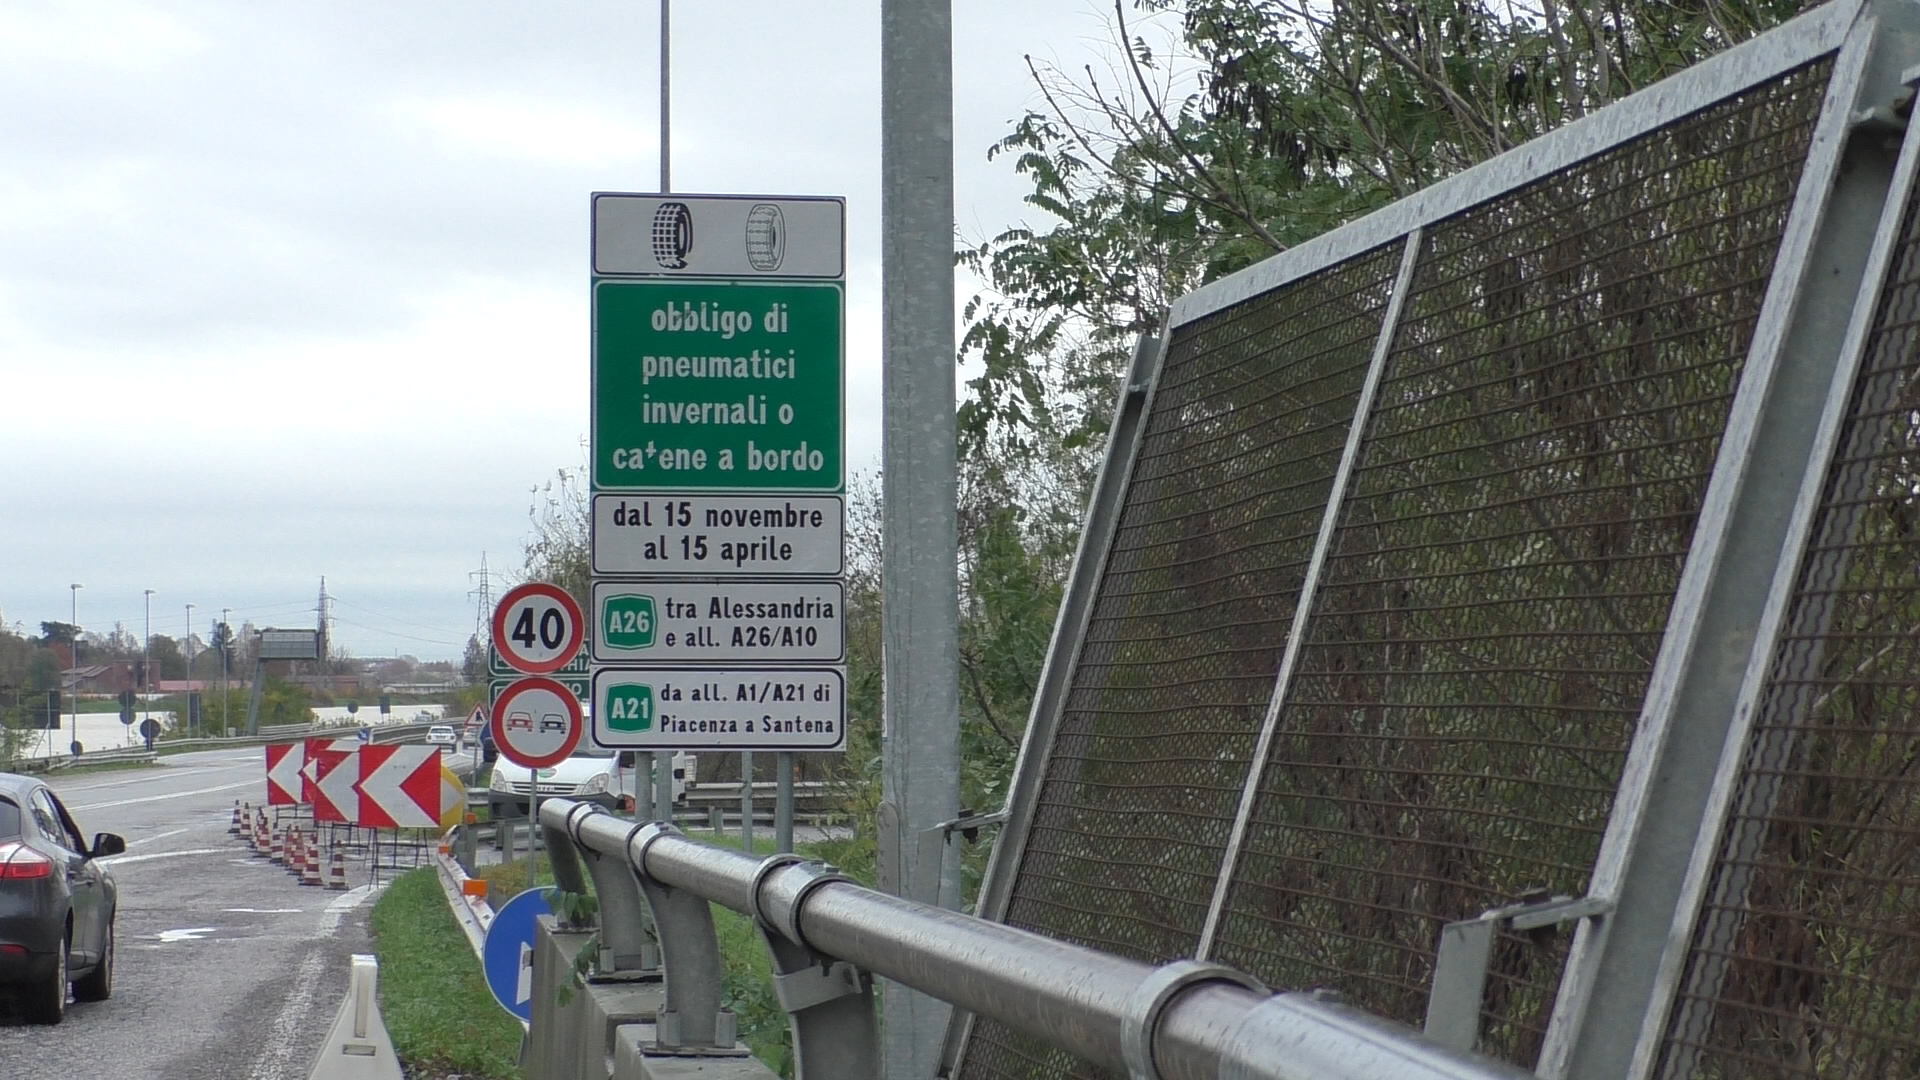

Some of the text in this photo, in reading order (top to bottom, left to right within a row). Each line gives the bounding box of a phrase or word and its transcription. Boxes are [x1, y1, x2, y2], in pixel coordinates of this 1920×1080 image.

[651, 302, 788, 339] obbligo di
[642, 349, 796, 384] pneumatici
[642, 394, 794, 424] invernali o
[718, 451, 734, 470] a
[748, 441, 824, 471] bordo
[613, 501, 823, 528] dal 15 novembre
[644, 535, 792, 567] al 15 aprile
[666, 597, 834, 619] tra Alessandria
[512, 608, 565, 650] 40
[609, 612, 650, 633] A26
[666, 626, 817, 647] e all. A26/A10
[661, 683, 830, 702] da all. A1/A21 di
[612, 698, 648, 719] A21
[661, 715, 834, 733] Piacenza a Santena
